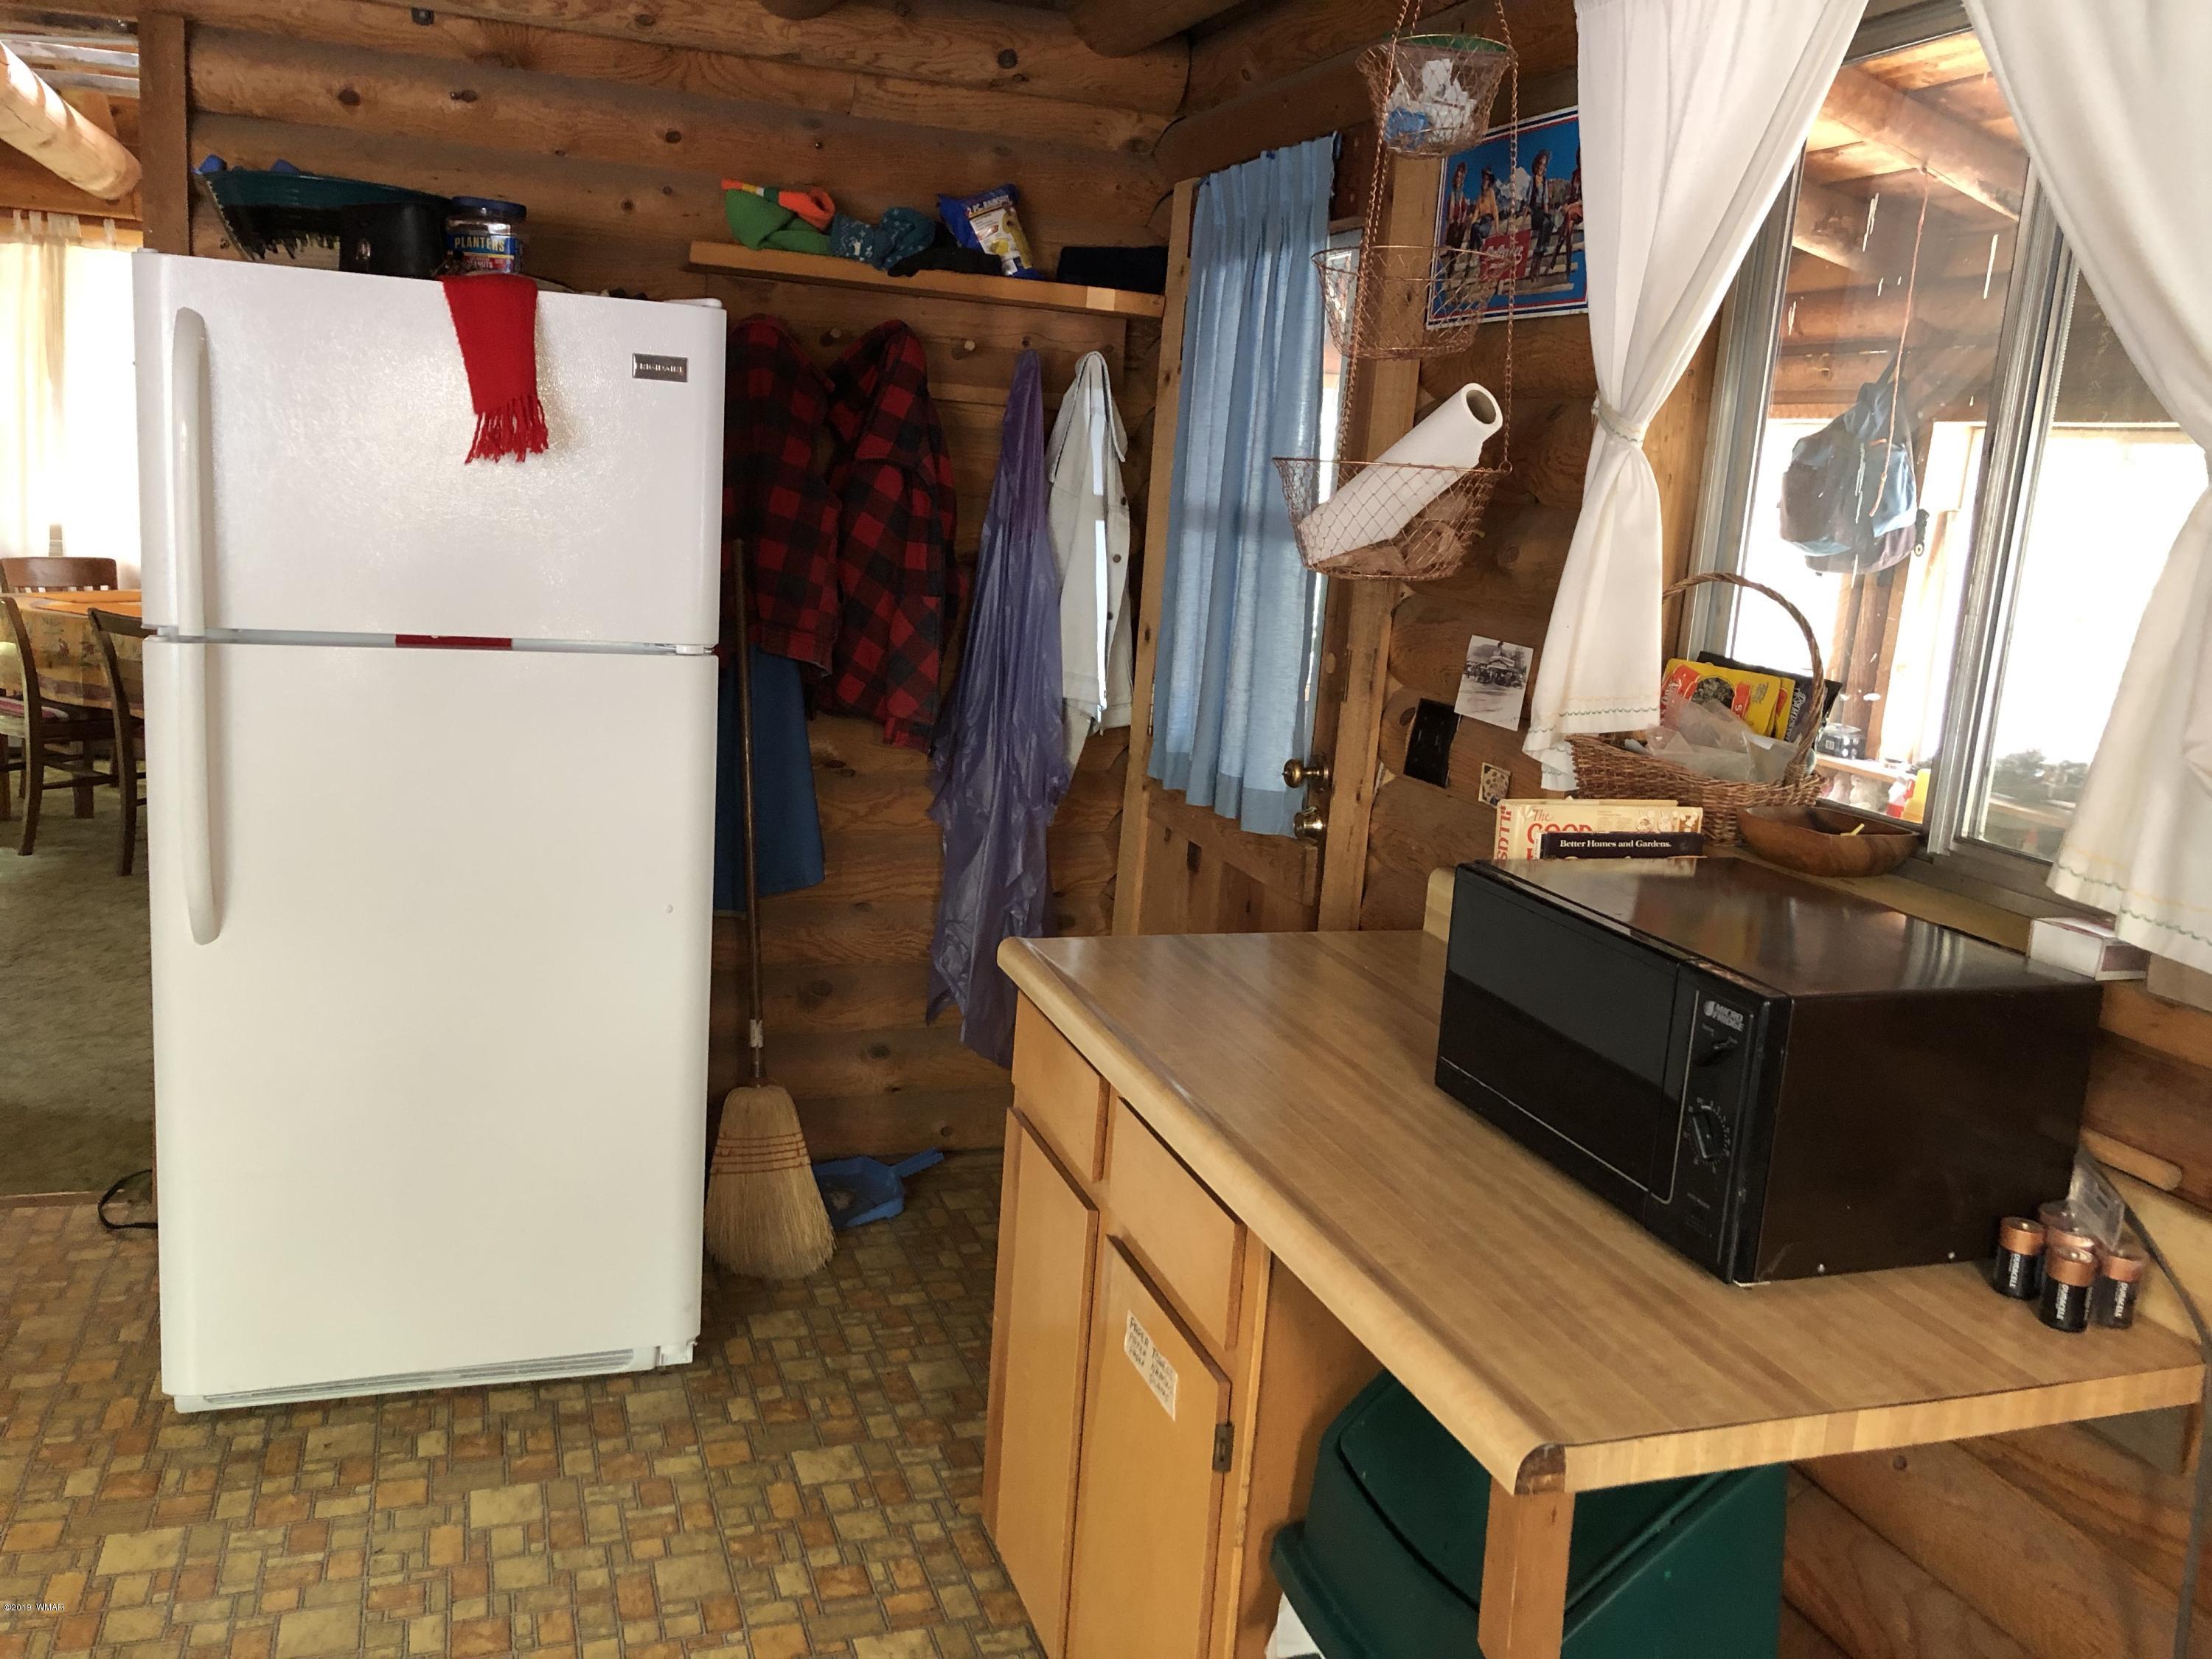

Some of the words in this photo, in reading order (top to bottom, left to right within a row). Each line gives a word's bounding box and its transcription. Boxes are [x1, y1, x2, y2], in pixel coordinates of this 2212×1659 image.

[454, 236, 505, 252] PLANTERS
[1533, 809, 1554, 821] The
[1559, 839, 1586, 847] Better
[1587, 839, 1617, 847] Homes
[1618, 839, 1634, 847] and
